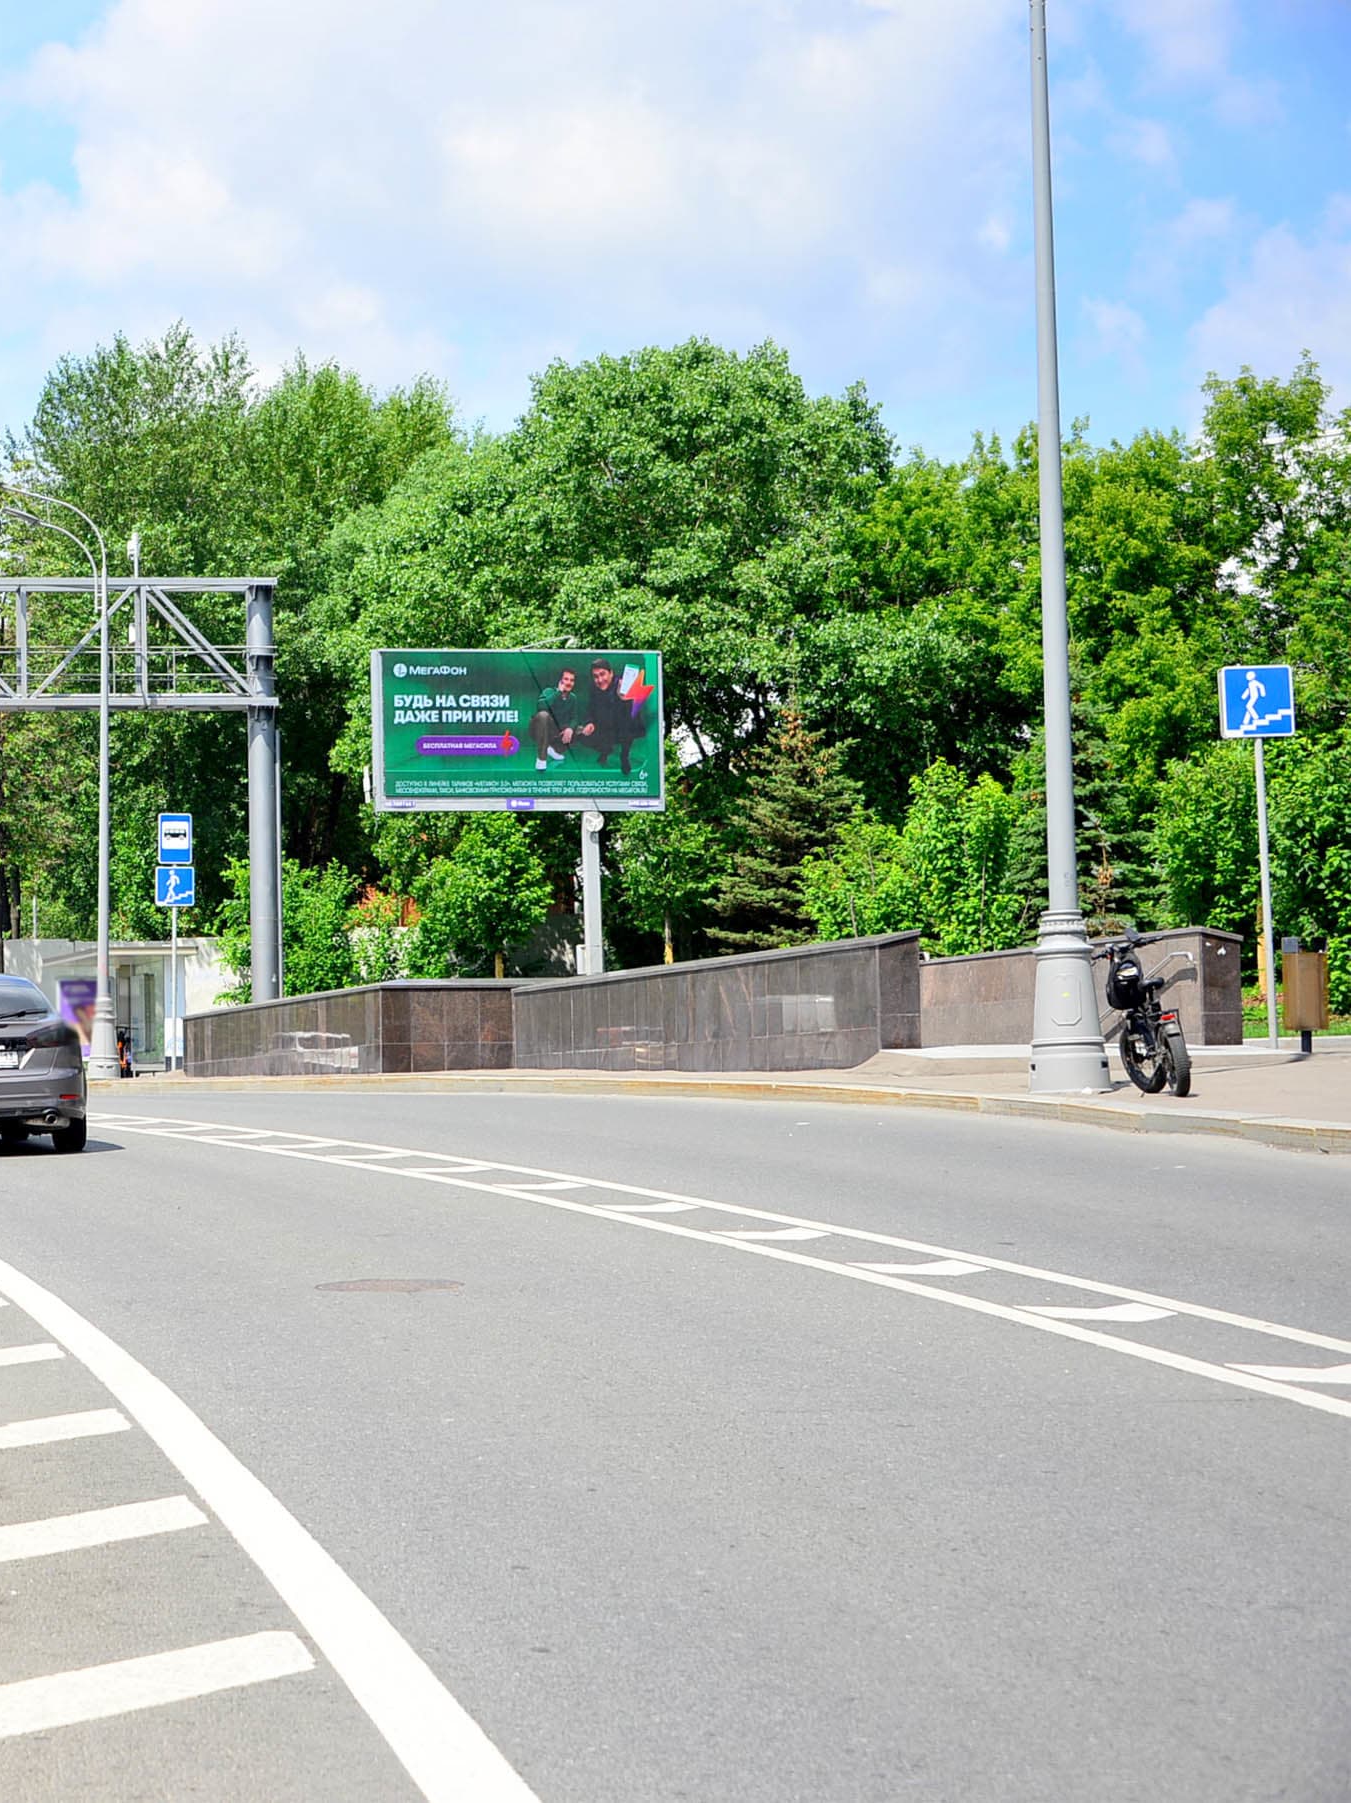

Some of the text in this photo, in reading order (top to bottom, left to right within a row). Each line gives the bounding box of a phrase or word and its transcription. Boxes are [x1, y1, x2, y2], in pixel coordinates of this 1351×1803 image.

[393, 694, 510, 709] БУДЬ НА СВЯЗИ
[393, 710, 519, 725] ДАЖЕ ПРИ НУЛЕ!
